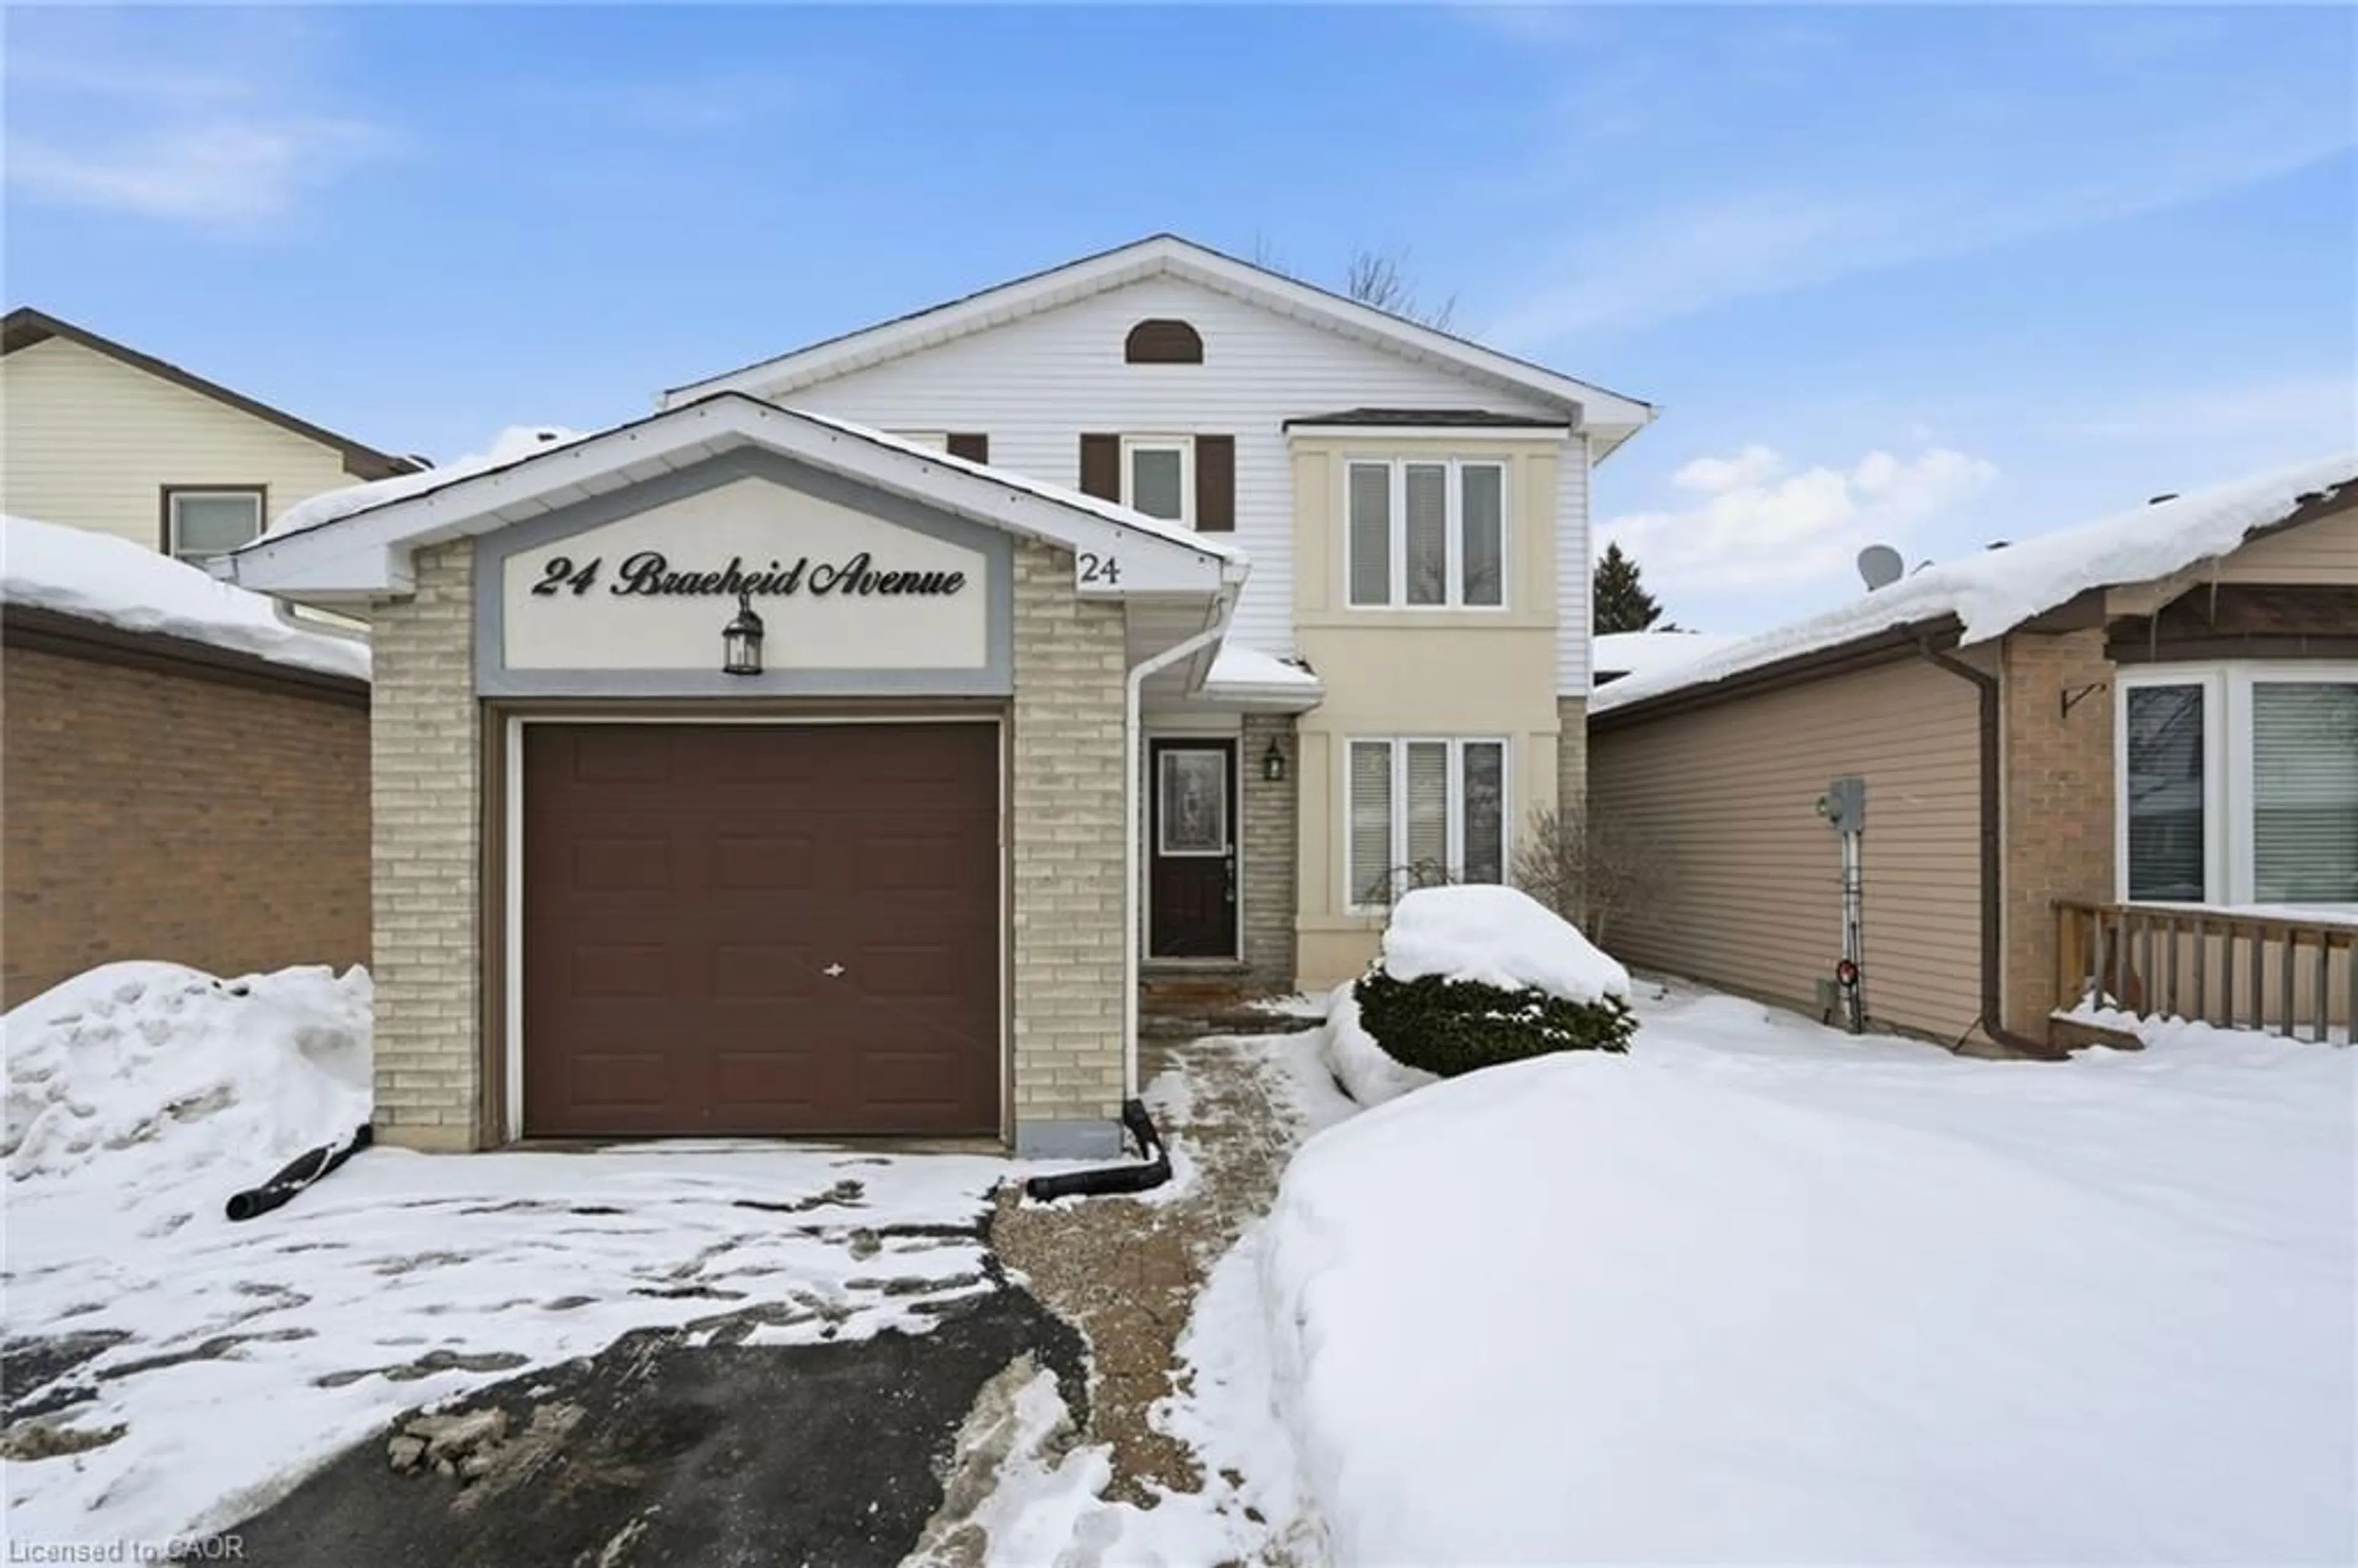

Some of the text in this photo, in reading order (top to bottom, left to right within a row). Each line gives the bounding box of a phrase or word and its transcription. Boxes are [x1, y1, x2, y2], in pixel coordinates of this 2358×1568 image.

[531, 551, 967, 596] 24 Braeheid Avenue
[1078, 553, 1121, 584] 24
